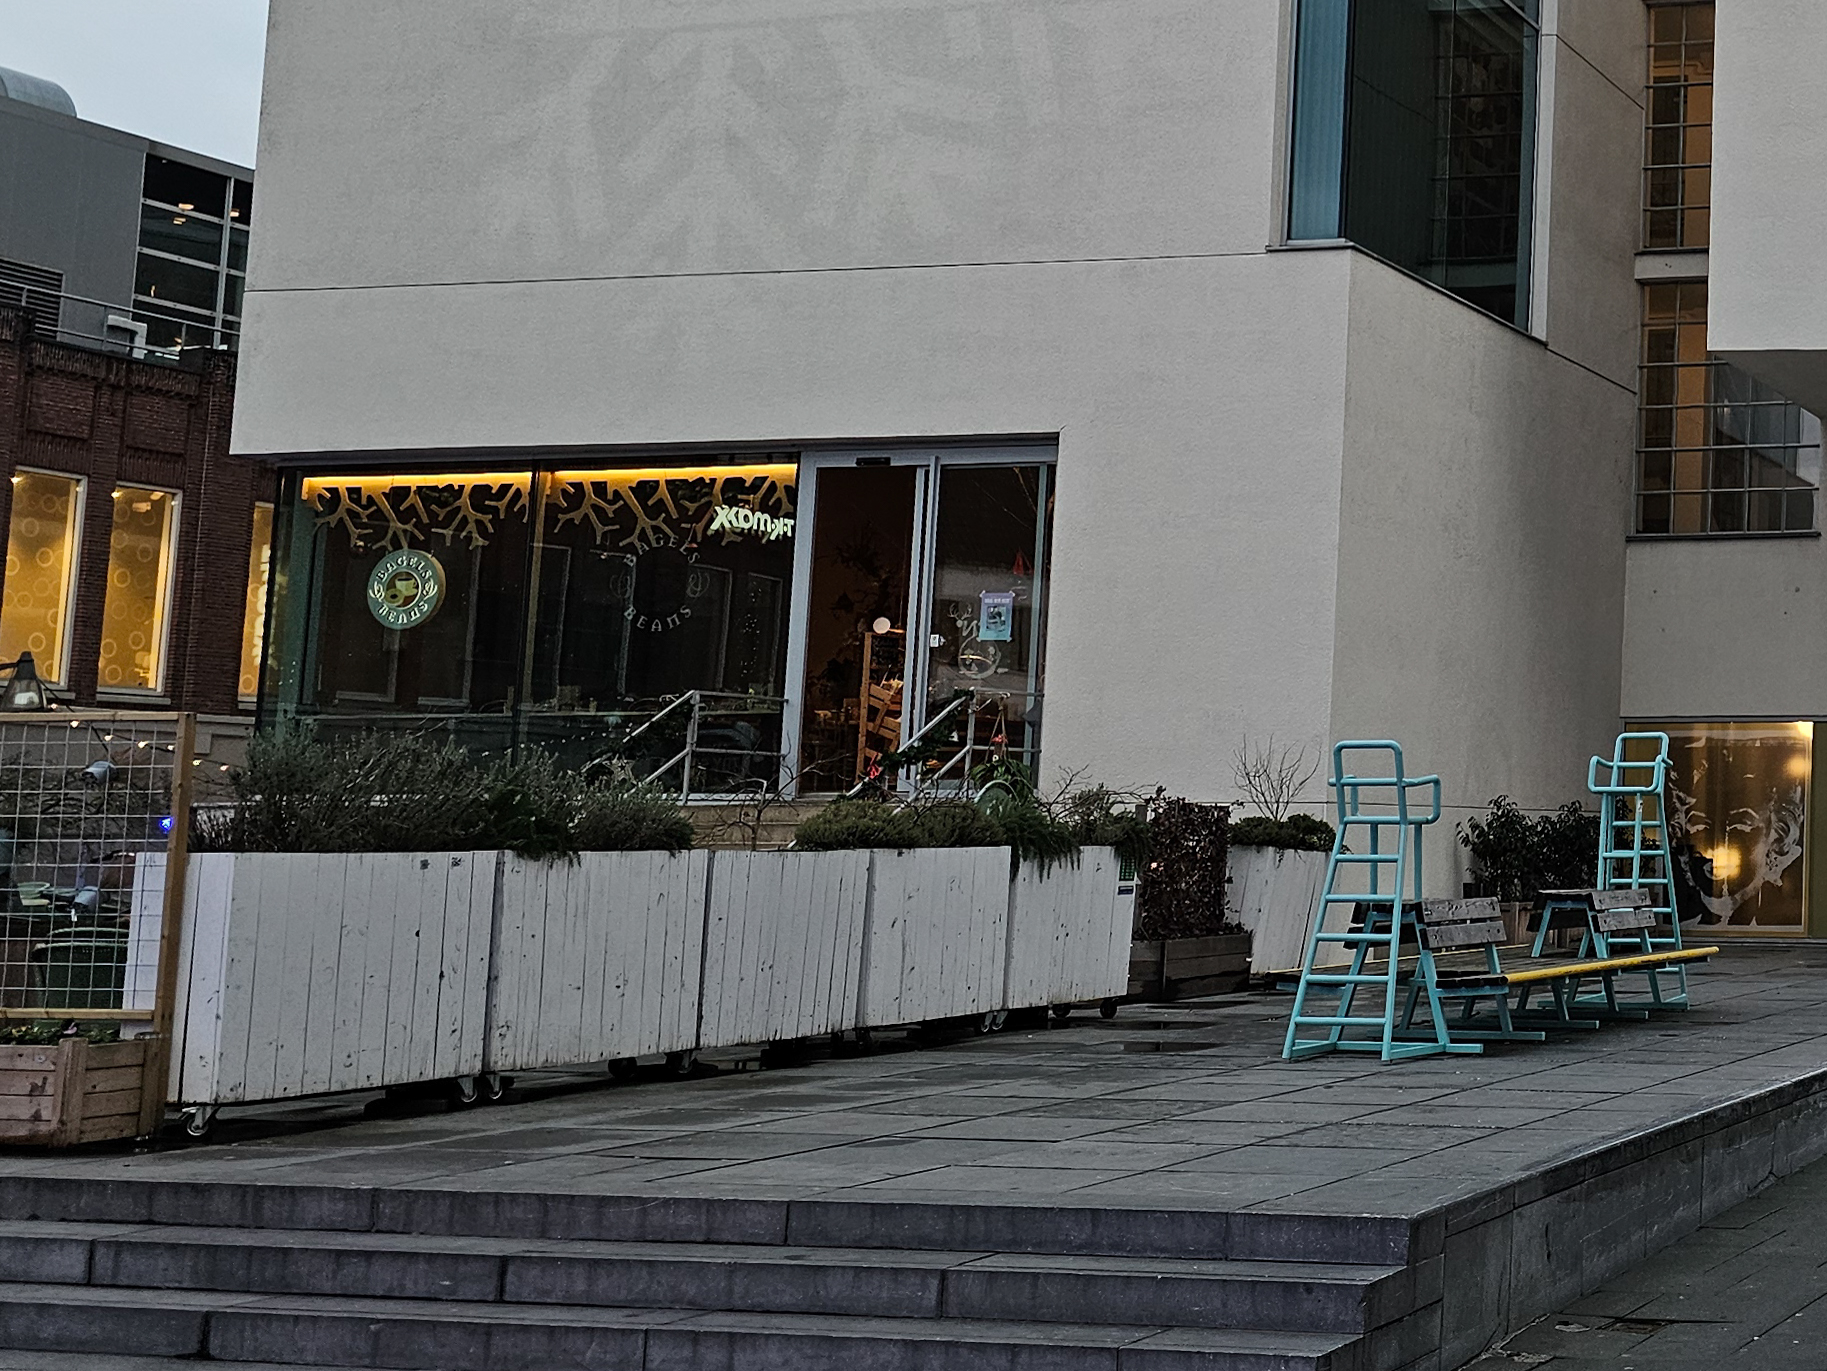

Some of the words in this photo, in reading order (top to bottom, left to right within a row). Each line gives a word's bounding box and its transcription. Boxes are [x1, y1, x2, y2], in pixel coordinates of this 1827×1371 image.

[623, 533, 701, 567] BAGELS
[375, 555, 433, 582] BAGELS
[623, 604, 692, 632] BEANS
